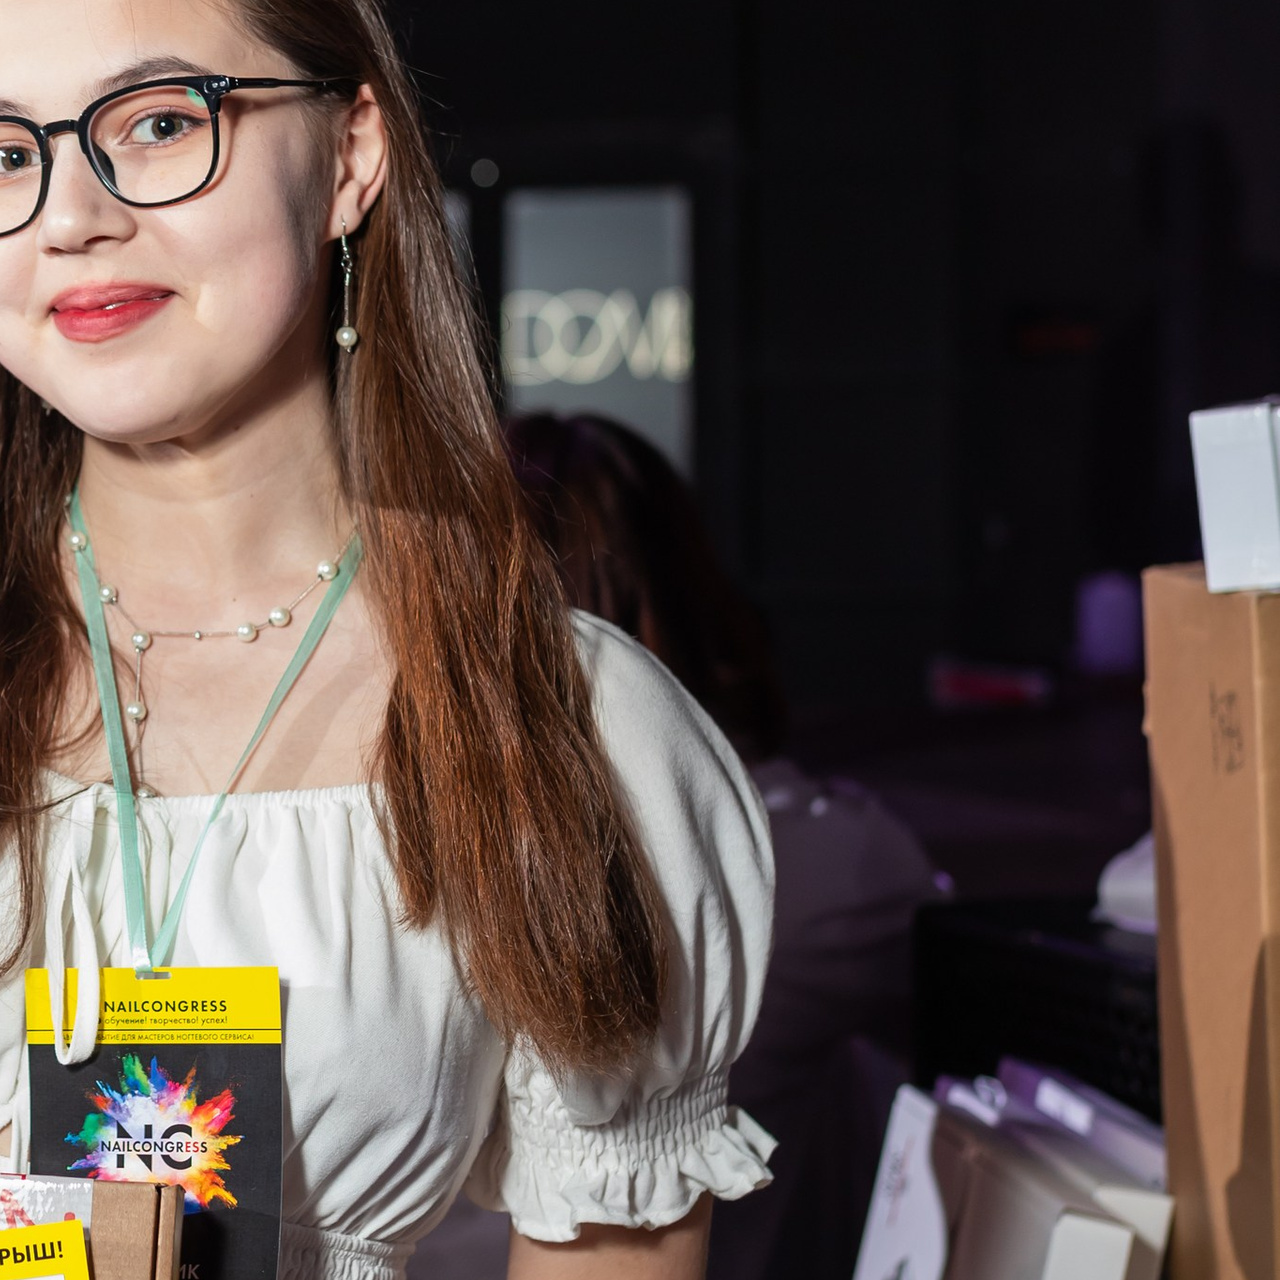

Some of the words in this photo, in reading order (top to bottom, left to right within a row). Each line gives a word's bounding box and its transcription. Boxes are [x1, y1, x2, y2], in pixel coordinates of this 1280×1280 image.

[103, 1000, 228, 1013] NAILCONGRESS
[104, 1017, 148, 1025] обучение!
[149, 1017, 199, 1025] творчество!
[201, 1016, 228, 1024] успех!
[121, 1033, 137, 1041] ДЛЯ
[138, 1033, 175, 1041] МАСТЕРОВ
[177, 1033, 218, 1041] НОГТЕВОГО
[219, 1033, 255, 1041] СЕРВИСА!
[101, 1140, 208, 1153] NAILCONGRESS
